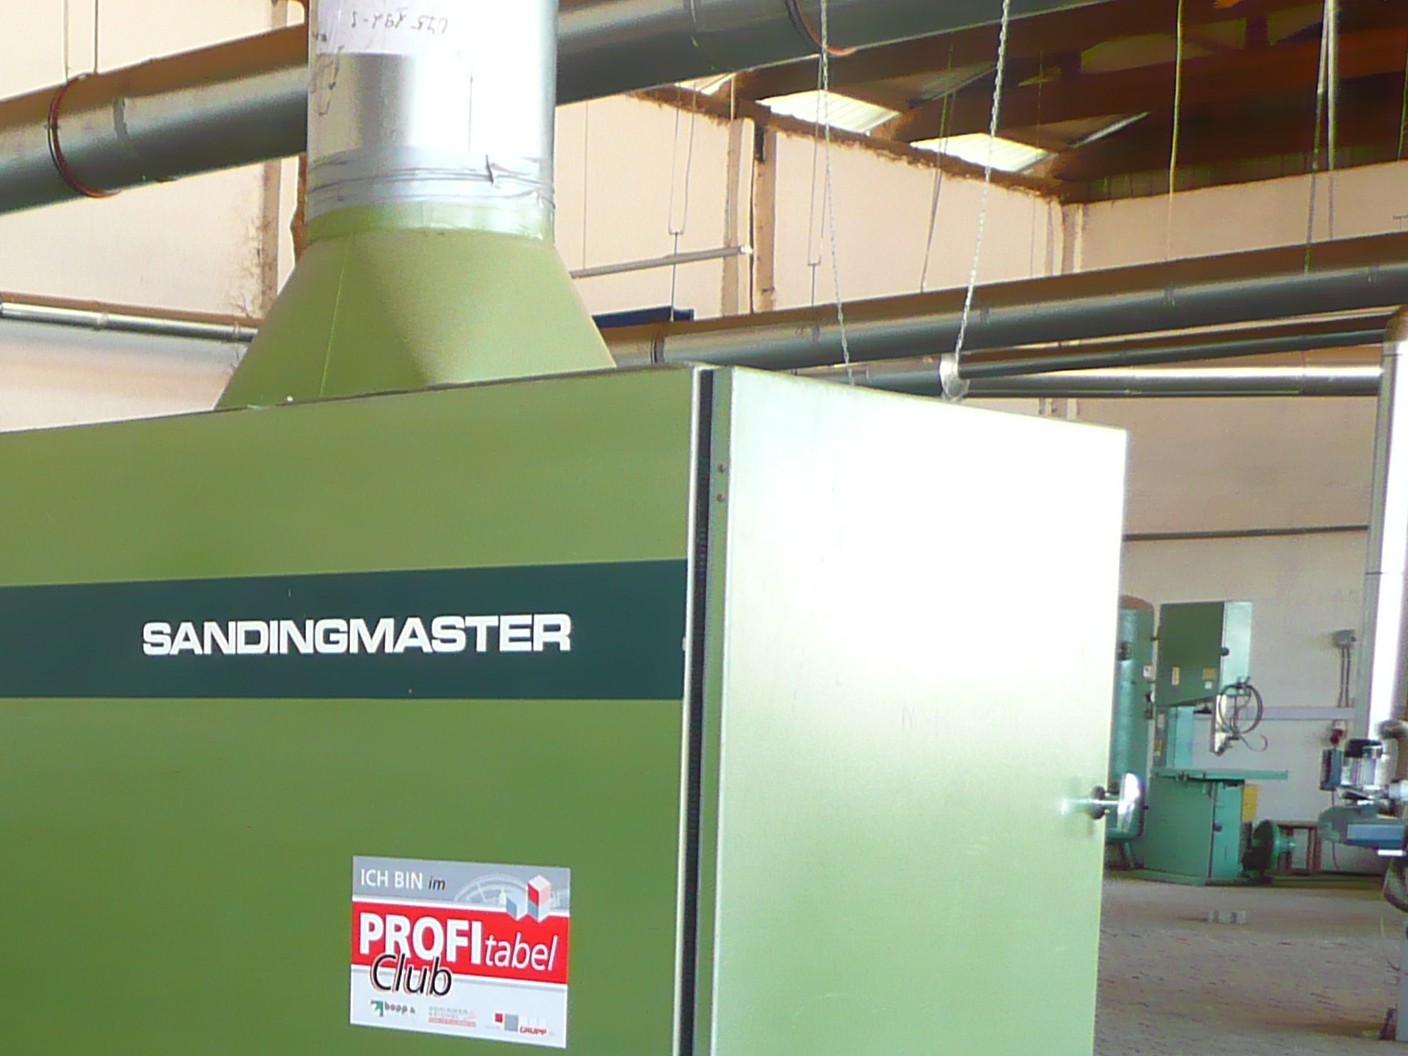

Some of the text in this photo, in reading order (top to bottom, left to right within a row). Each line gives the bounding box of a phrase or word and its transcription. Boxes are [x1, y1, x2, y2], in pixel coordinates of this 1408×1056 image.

[142, 613, 572, 656] SANDINGMASTER
[360, 868, 446, 891] ICH BIN im
[371, 953, 453, 997] Club
